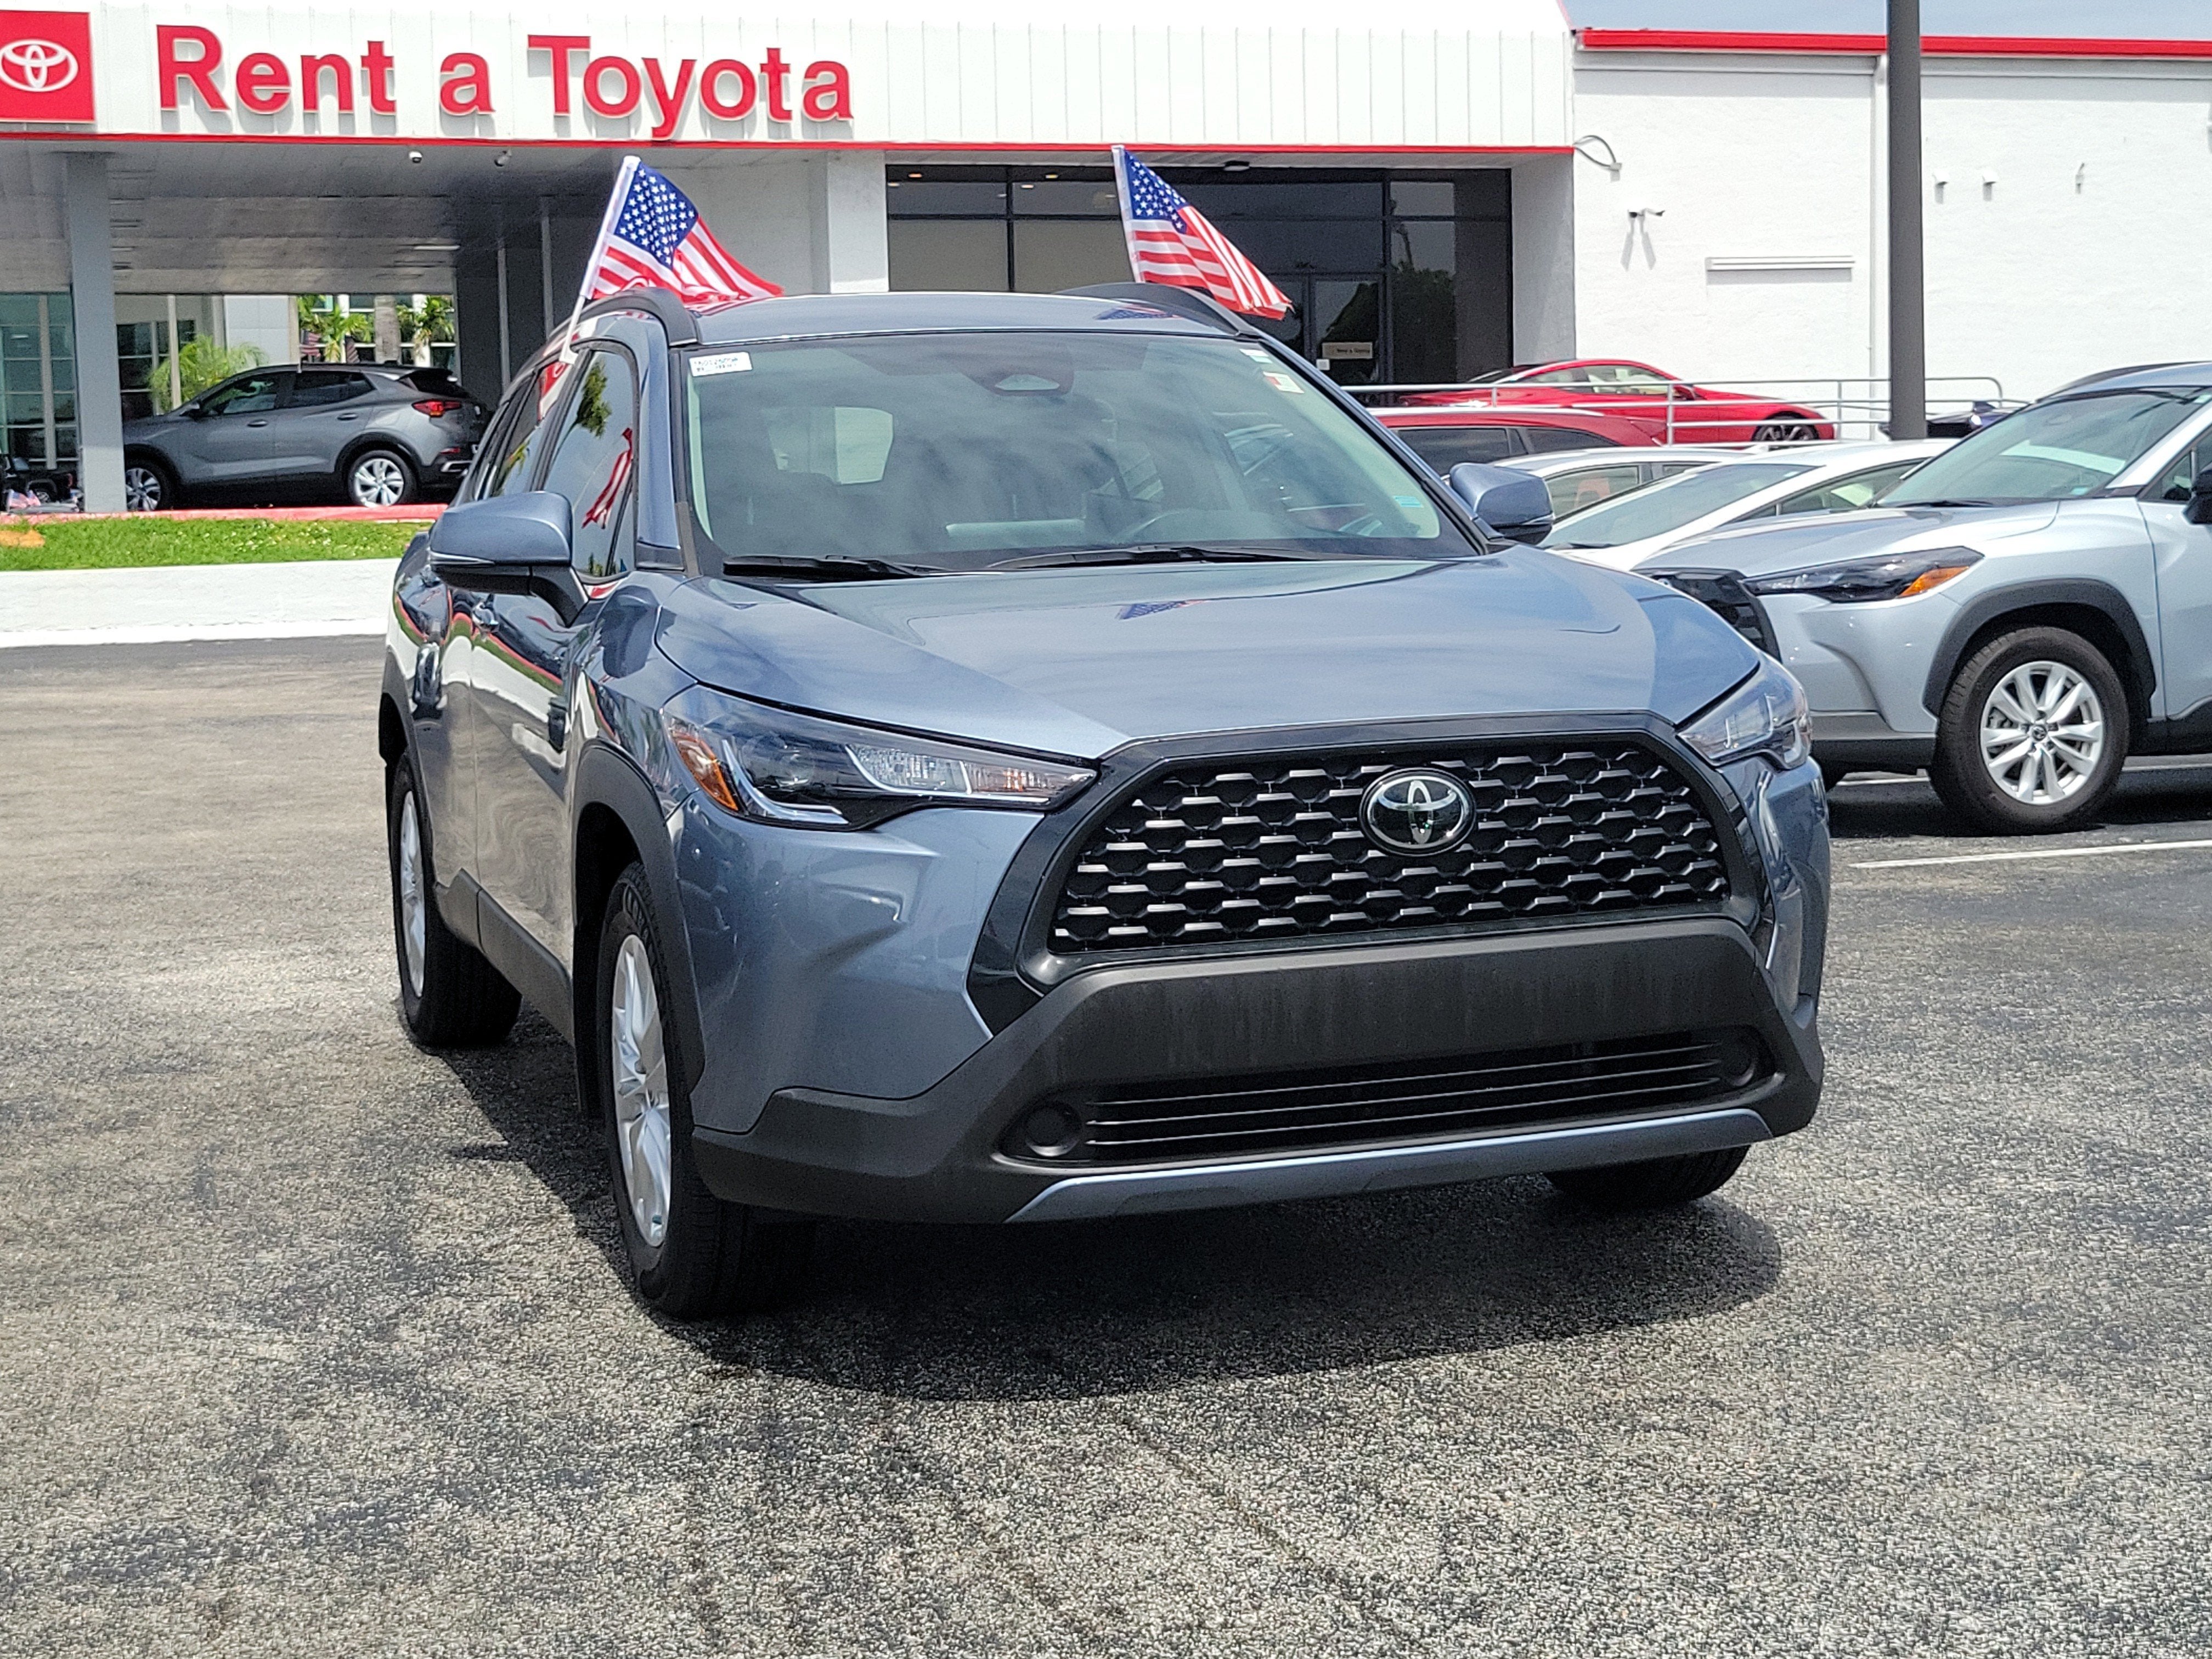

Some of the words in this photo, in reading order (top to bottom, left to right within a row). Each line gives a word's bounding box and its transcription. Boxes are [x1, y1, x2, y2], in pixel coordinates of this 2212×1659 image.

[157, 25, 396, 113] Rent
[440, 53, 493, 114] a
[527, 35, 853, 139] Toyota
